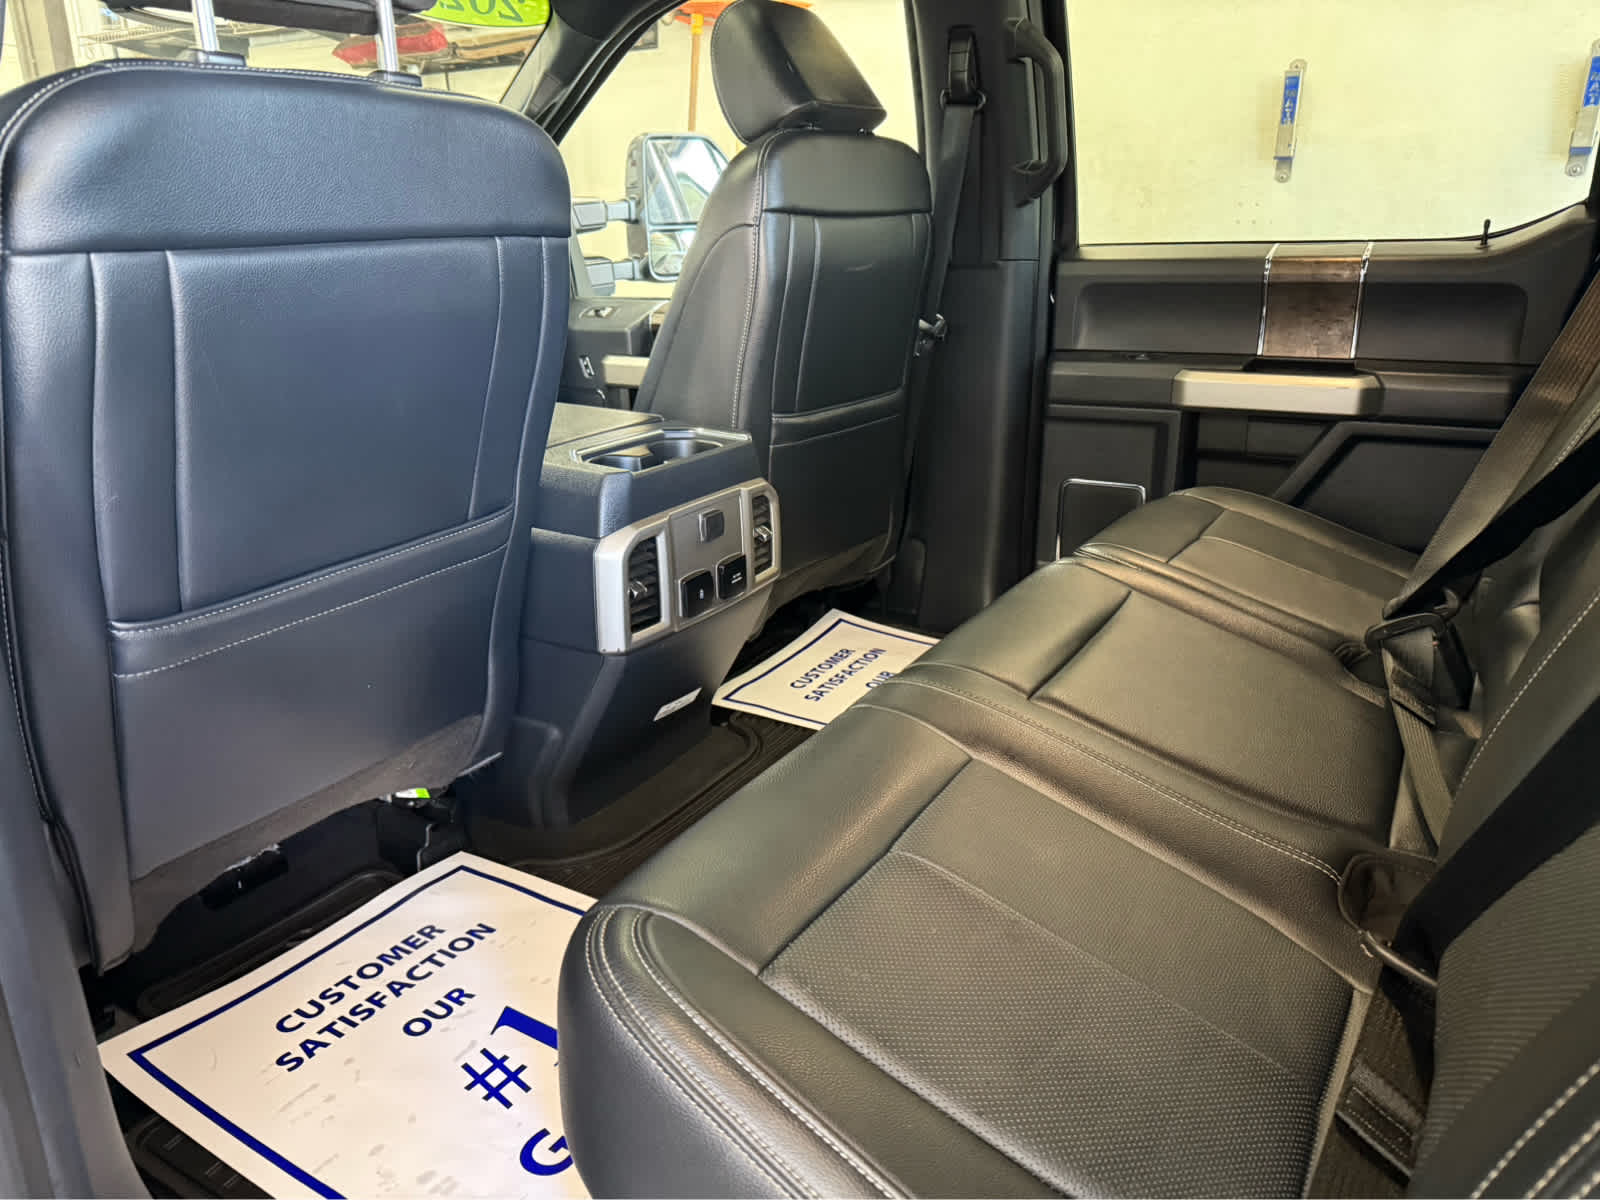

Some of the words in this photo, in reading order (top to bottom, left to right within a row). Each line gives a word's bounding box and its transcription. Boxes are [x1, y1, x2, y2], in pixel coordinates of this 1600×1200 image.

[790, 648, 856, 689] CUSTOMER
[804, 647, 886, 702] SATISFACTION
[275, 924, 446, 1034] CUSTOMER
[275, 922, 497, 1073] SATISFACTION
[402, 987, 476, 1037] OUR
